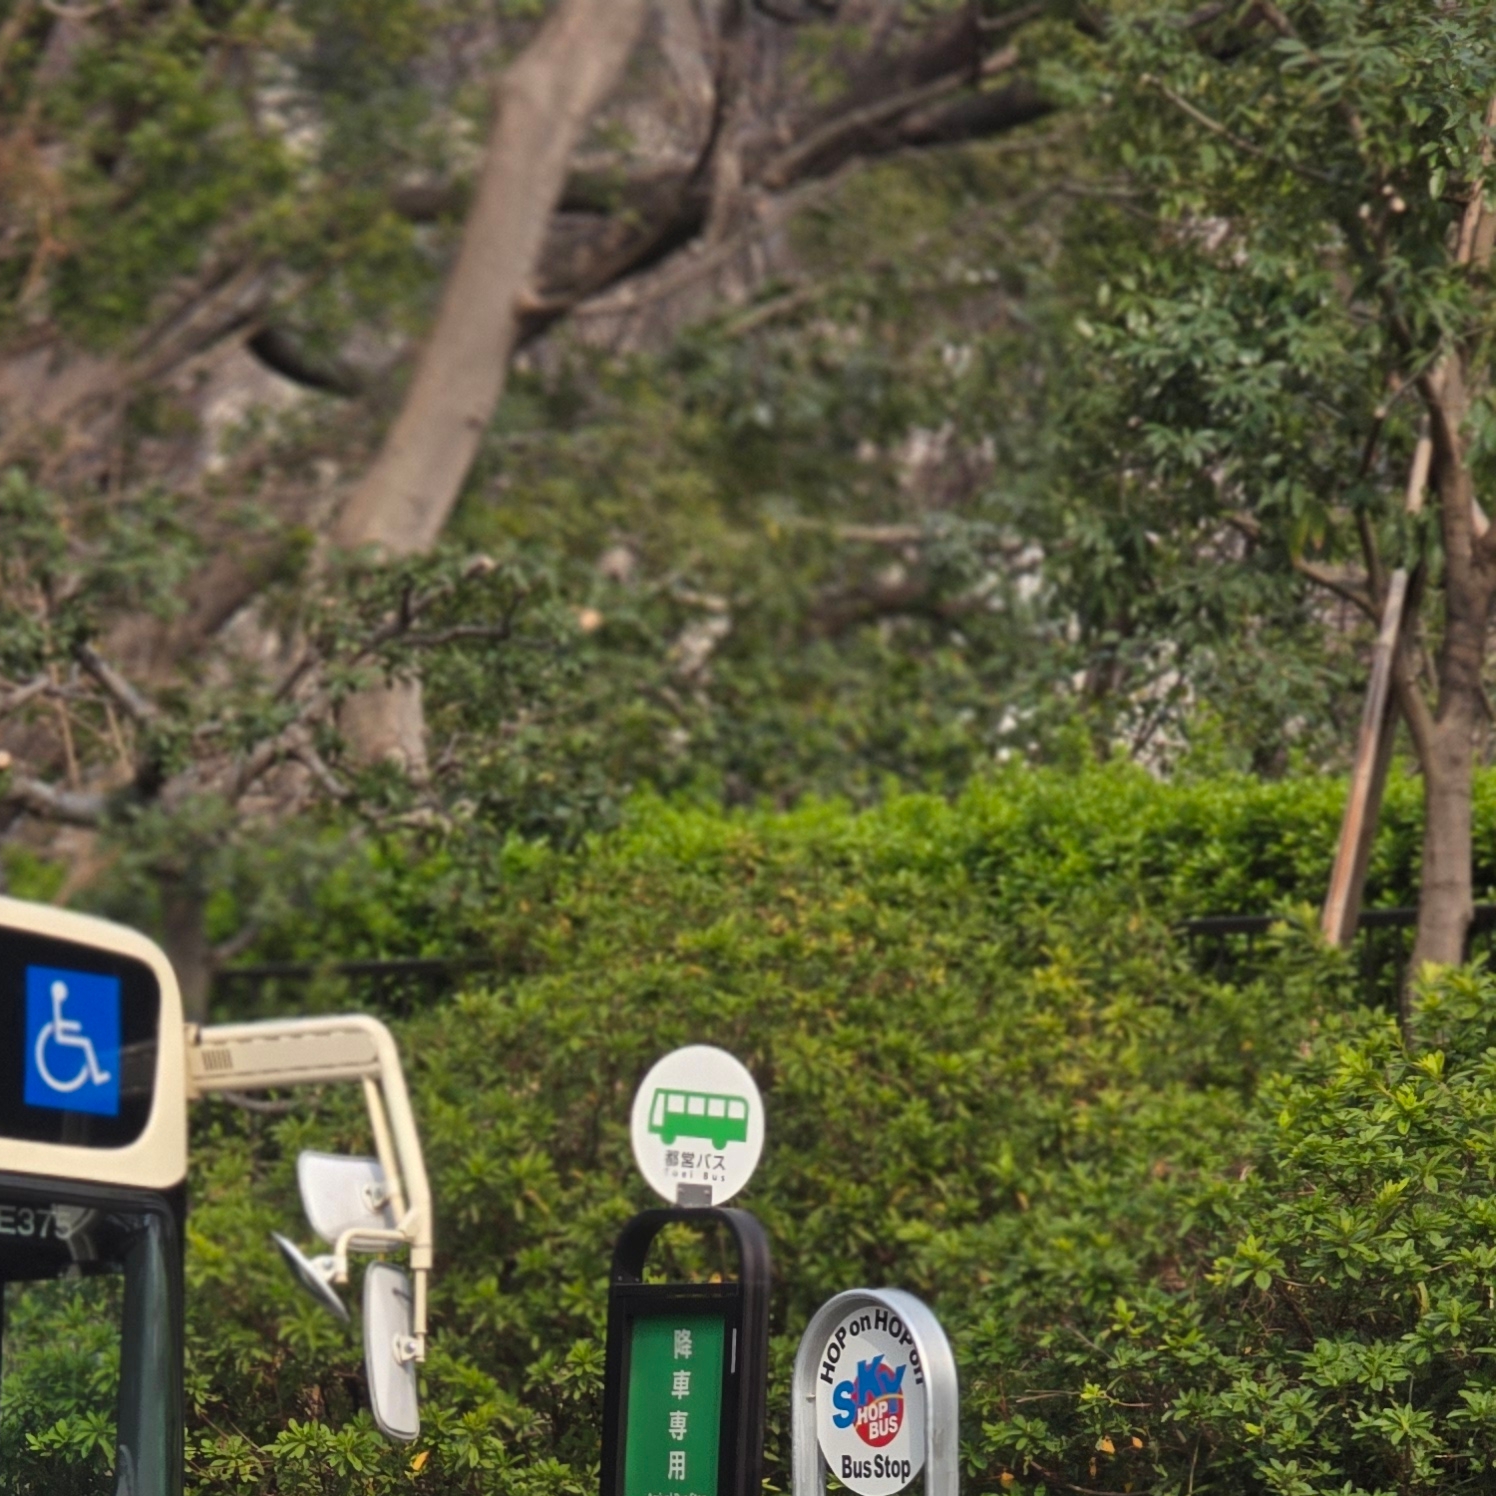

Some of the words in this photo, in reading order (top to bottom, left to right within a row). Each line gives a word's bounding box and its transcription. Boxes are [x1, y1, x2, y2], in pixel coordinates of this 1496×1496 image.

[665, 1149, 726, 1170] 都営バス
[703, 1172, 725, 1182] Bus
[820, 1327, 846, 1385] HOP
[849, 1314, 871, 1336] on
[874, 1309, 913, 1346] HOP
[668, 1328, 692, 1480] 降車専用
[857, 1401, 888, 1425] HOP
[869, 1415, 898, 1440] BUS
[842, 1455, 872, 1479] Bus
[874, 1454, 911, 1483] Stop
